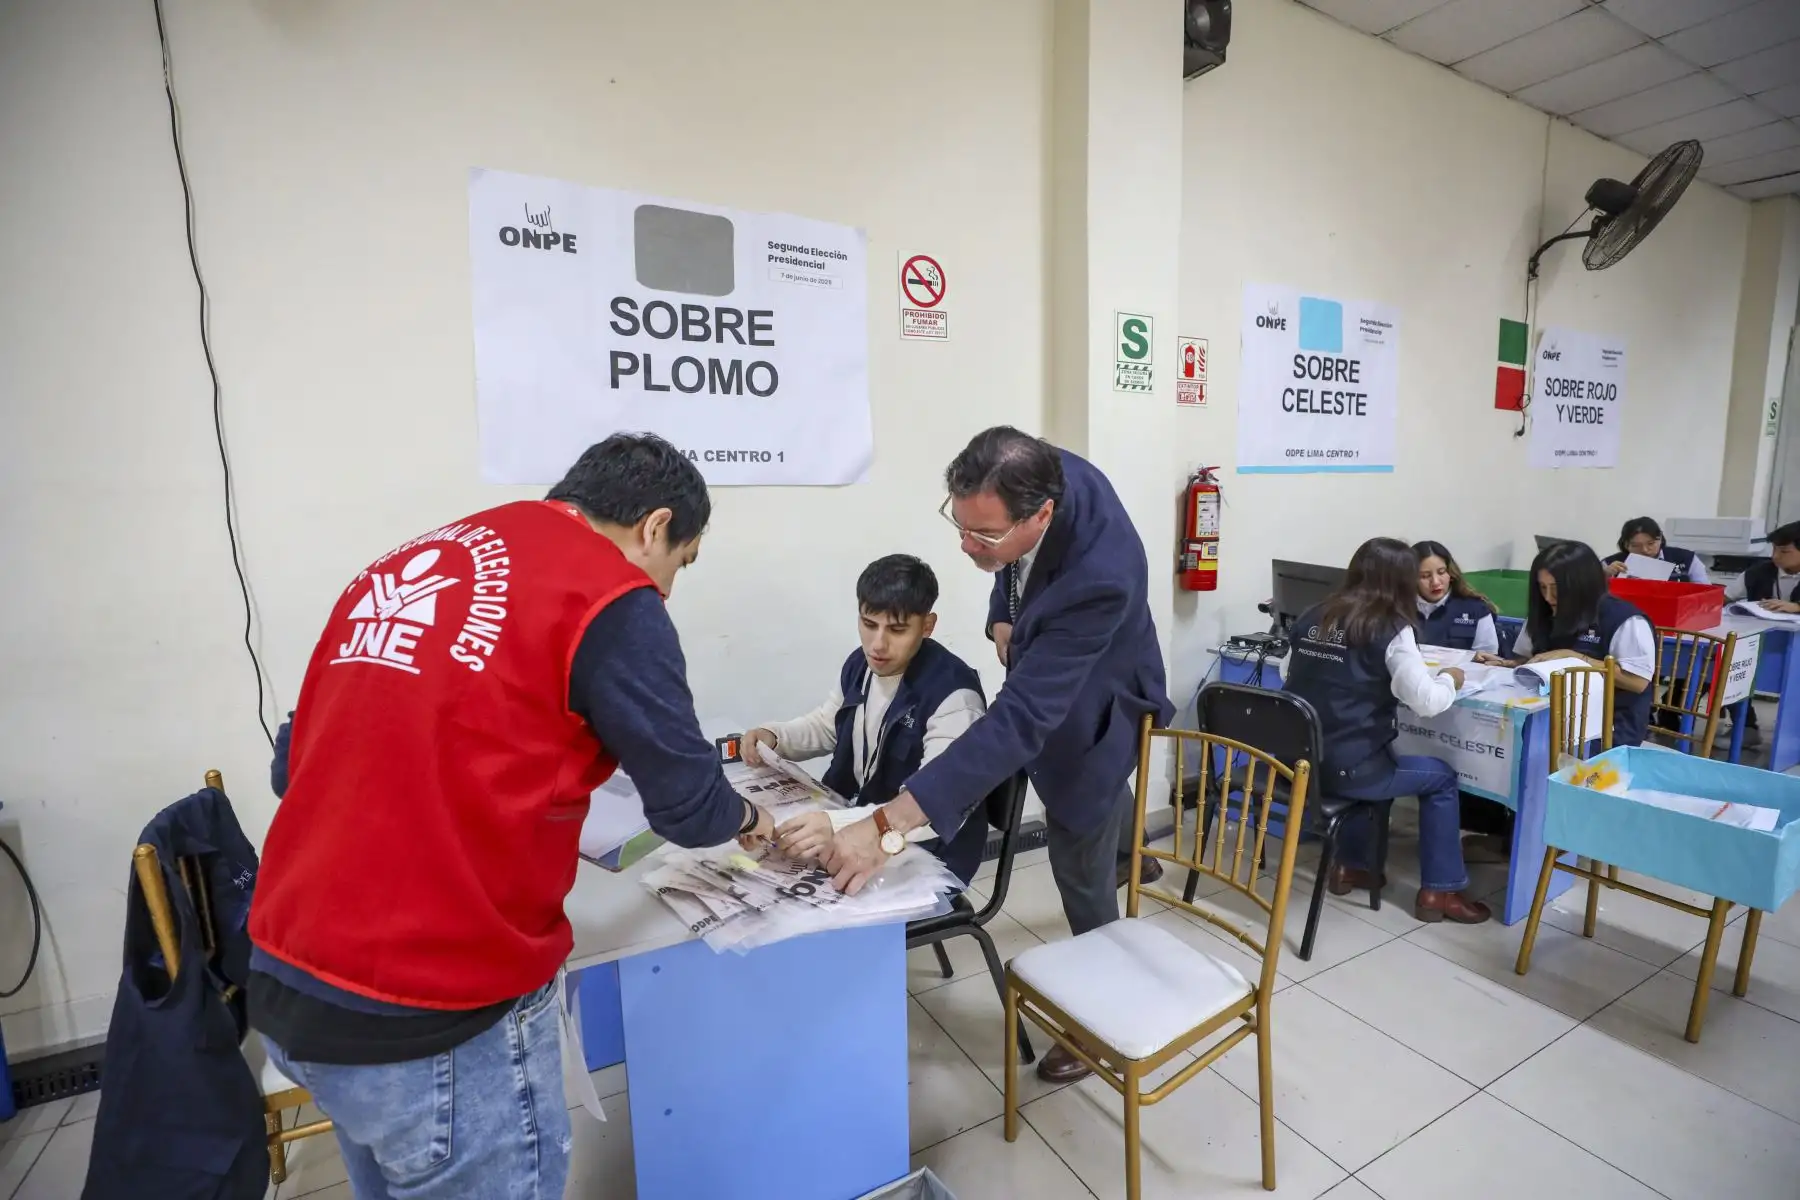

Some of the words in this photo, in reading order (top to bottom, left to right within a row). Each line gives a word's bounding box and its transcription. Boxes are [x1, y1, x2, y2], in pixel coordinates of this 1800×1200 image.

[499, 226, 577, 254] ONPE
[768, 241, 810, 255] Segunda
[811, 247, 848, 261] Elección
[768, 254, 825, 271] Presidencial
[610, 296, 775, 346] SOBRE
[905, 311, 945, 320] PROHIBIDO
[1256, 315, 1287, 331] ONPE
[1121, 318, 1149, 360] S
[610, 350, 779, 397] PLOMO
[1293, 354, 1360, 383] SOBRE
[1282, 388, 1367, 416] CELESTE
[1545, 378, 1584, 398] SOBRE
[1587, 381, 1617, 401] ROJO
[1556, 404, 1564, 422] Y
[1567, 404, 1604, 424] VERDE
[704, 450, 771, 463] CENTRO
[777, 451, 784, 463] 1
[1285, 448, 1304, 458] ODPE
[1307, 449, 1324, 458] LIMA
[1326, 449, 1354, 458] CENTRO
[450, 538, 510, 672] ELECCIONES
[339, 622, 424, 665] JNE
[1400, 722, 1436, 739] OBRE
[1440, 732, 1505, 759] CELESTE
